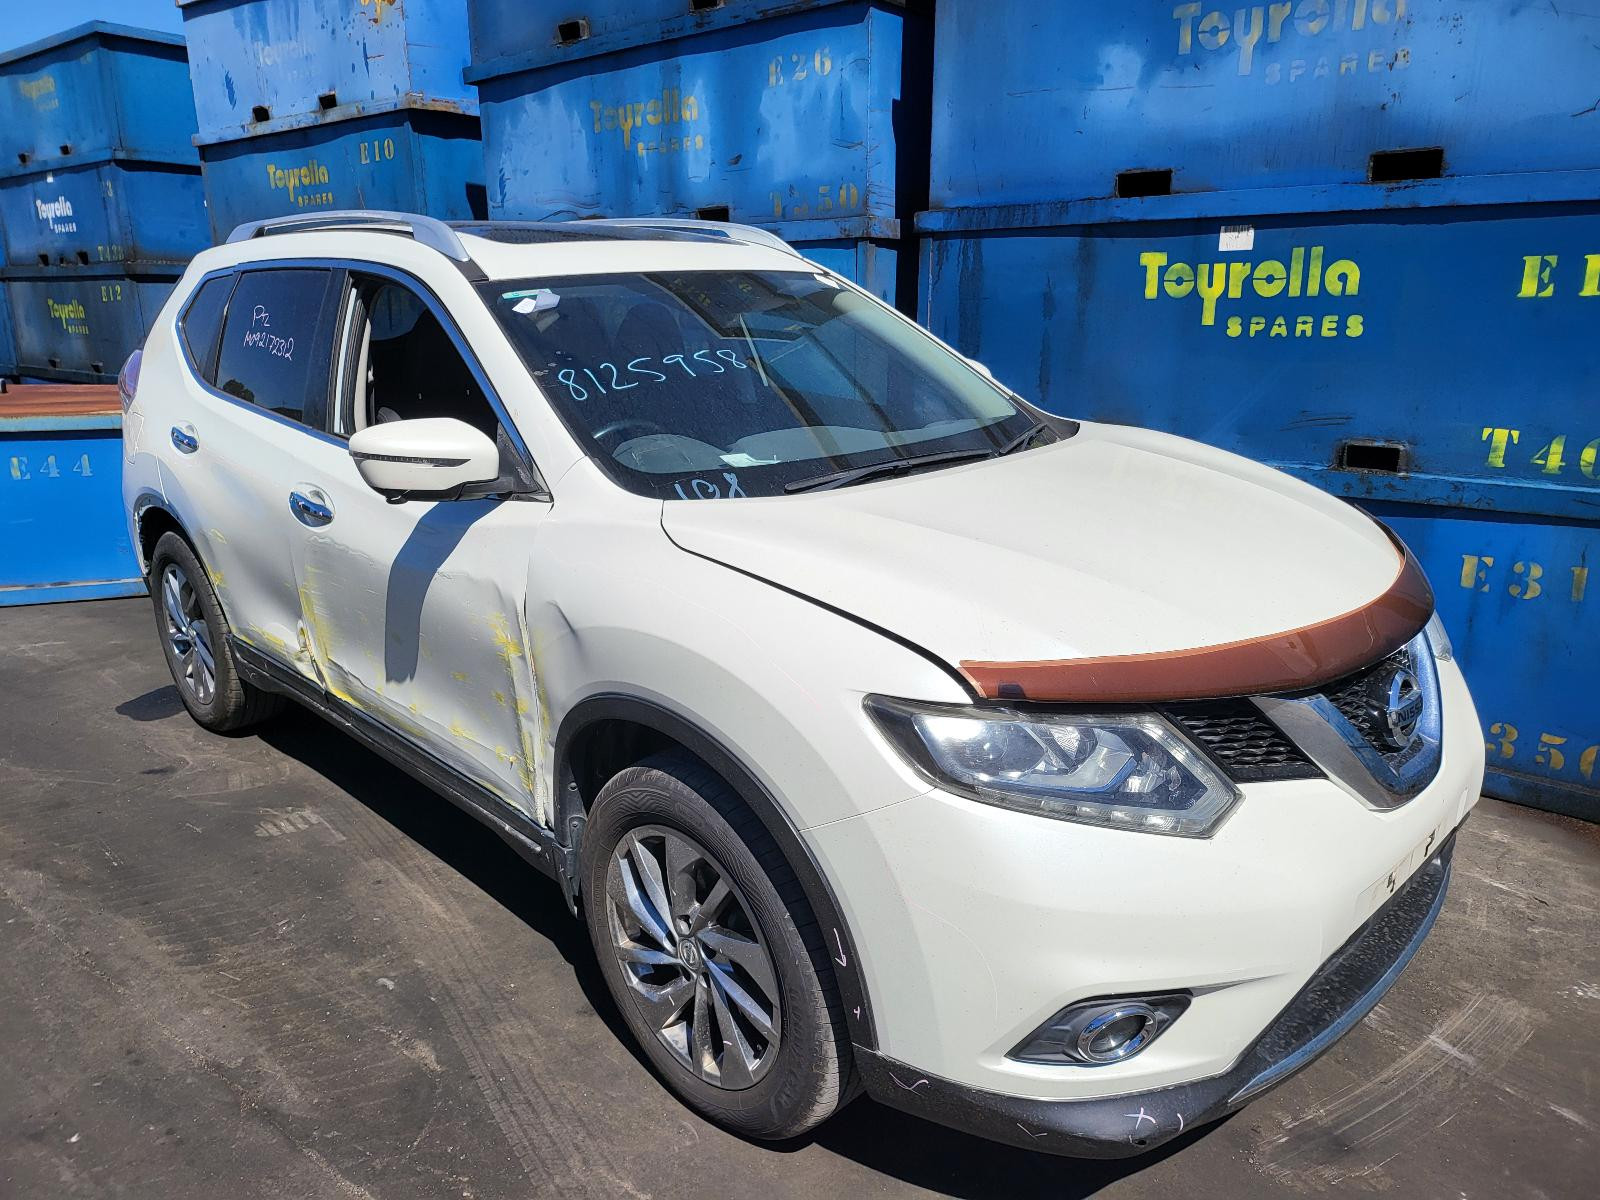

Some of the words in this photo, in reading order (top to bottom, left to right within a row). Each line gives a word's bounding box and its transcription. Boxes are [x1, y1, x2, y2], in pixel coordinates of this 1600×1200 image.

[768, 47, 833, 89] E26
[1264, 48, 1411, 86] SPARES
[360, 138, 395, 165] E10
[297, 192, 334, 208] SPARES
[101, 284, 122, 302] E12
[1139, 245, 1361, 326] Toyrolla
[1226, 314, 1365, 338] SPARES
[558, 349, 748, 401] 8125958
[10, 453, 94, 480] E44
[1460, 554, 1589, 602] E31
